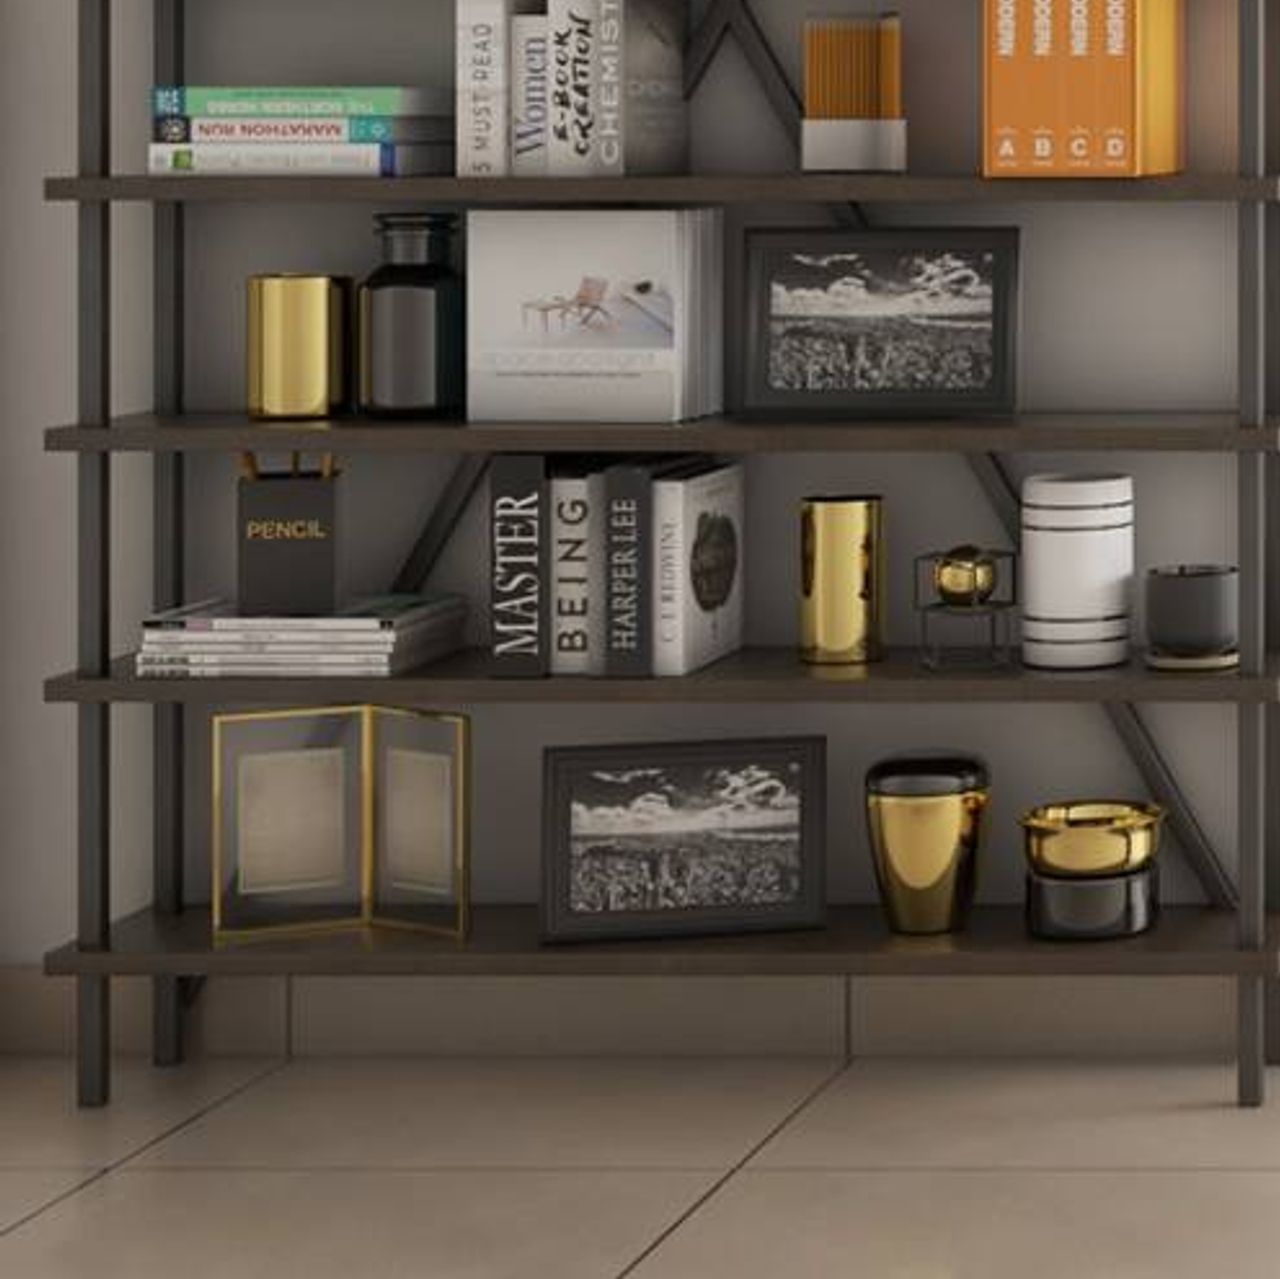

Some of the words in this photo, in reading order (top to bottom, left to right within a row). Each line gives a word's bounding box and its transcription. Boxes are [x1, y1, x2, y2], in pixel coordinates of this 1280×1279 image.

[472, 23, 492, 80] READ
[515, 36, 546, 155] Women
[553, 28, 573, 141] E-BOOK
[569, 11, 594, 157] CREATION
[601, 1, 619, 165] CHEMIST
[199, 122, 235, 136] RUN
[240, 122, 342, 137] MARATHON
[472, 94, 491, 151] MUST
[998, 137, 1016, 157] A
[1070, 137, 1087, 157] C
[247, 520, 327, 540] PENCIL
[611, 498, 637, 544] LEE
[493, 491, 539, 655] MASTER
[557, 498, 588, 652] BEING
[611, 546, 637, 650] HARPER
